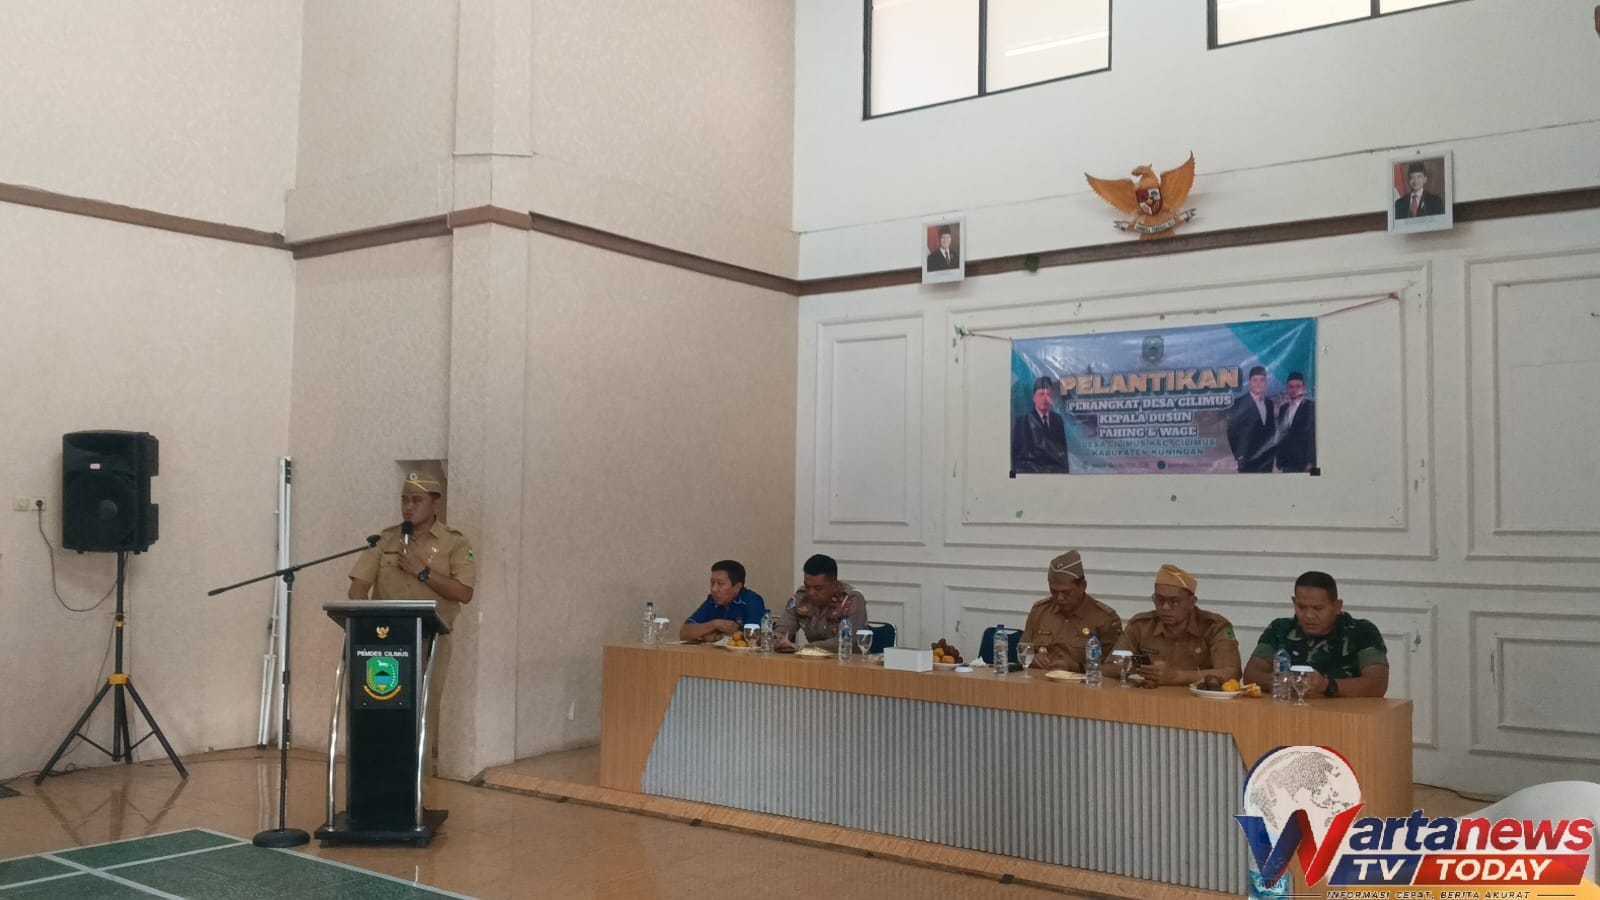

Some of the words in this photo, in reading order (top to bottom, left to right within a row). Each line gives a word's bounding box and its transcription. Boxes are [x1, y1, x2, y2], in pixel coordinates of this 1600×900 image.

[1060, 368, 1238, 395] PELANTIKAN
[1068, 400, 1140, 411] PERANGKAT
[1142, 398, 1176, 409] DESA
[1178, 395, 1232, 407] CILIMUS
[1100, 413, 1146, 424] KEPALA
[1149, 412, 1192, 423] DUSUN
[1099, 428, 1145, 438] PAHING
[1147, 427, 1157, 437] &
[1159, 426, 1198, 437] WAGE
